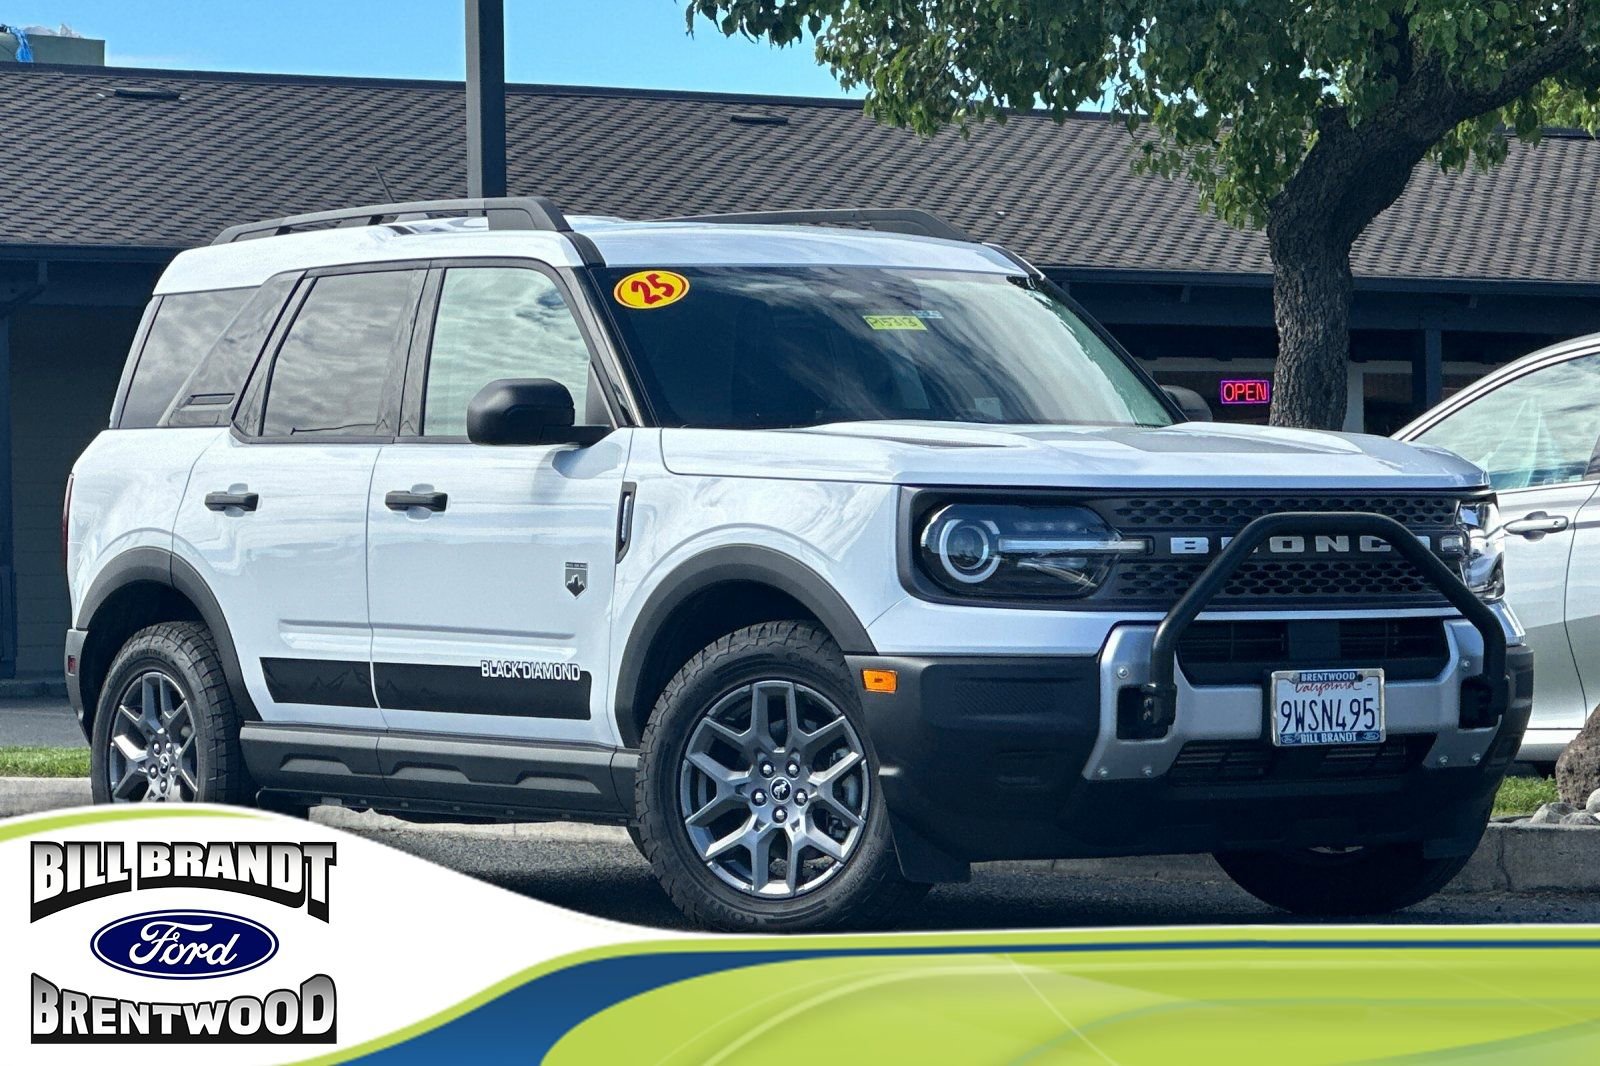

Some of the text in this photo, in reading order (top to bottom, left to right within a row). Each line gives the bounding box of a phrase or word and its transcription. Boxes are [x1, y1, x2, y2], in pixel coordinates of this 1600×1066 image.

[631, 273, 675, 304] 25
[1223, 383, 1267, 401] OPEN
[1170, 535, 1430, 553] BONC
[480, 660, 581, 681] BLACK DIAMOND
[1301, 672, 1356, 682] BRENTWOOD
[1280, 698, 1375, 733] 9WSN495
[1300, 732, 1320, 743] BILL
[1321, 732, 1358, 743] BRANDT
